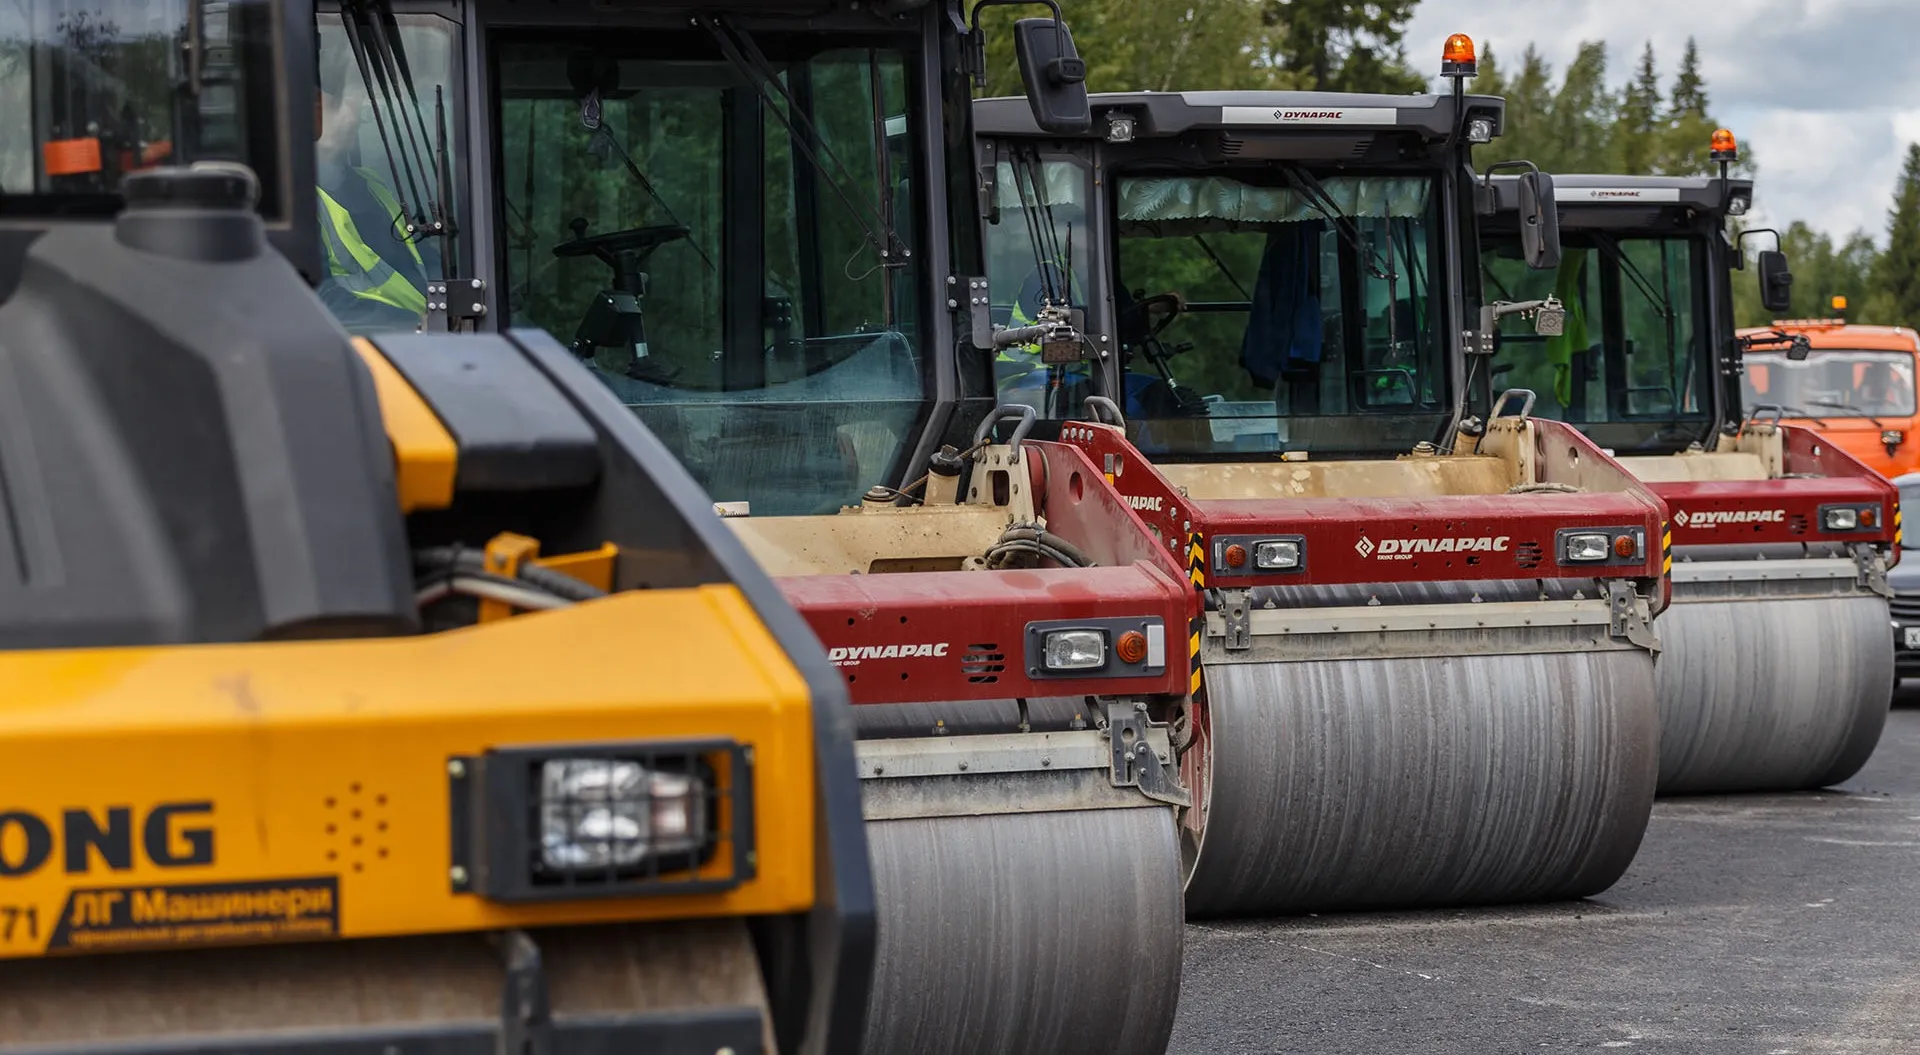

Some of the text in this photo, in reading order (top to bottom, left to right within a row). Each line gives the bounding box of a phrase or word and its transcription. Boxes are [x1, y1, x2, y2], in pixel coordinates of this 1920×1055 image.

[1283, 111, 1344, 119] DYNAPAC
[1121, 495, 1163, 511] NAPAC
[1690, 510, 1786, 523] DYNAPAC
[1377, 536, 1510, 554] DYNAPAC
[828, 643, 949, 660] DYNAPAC
[0, 802, 215, 877] ONG
[70, 886, 332, 926] ЛГ Машинери
